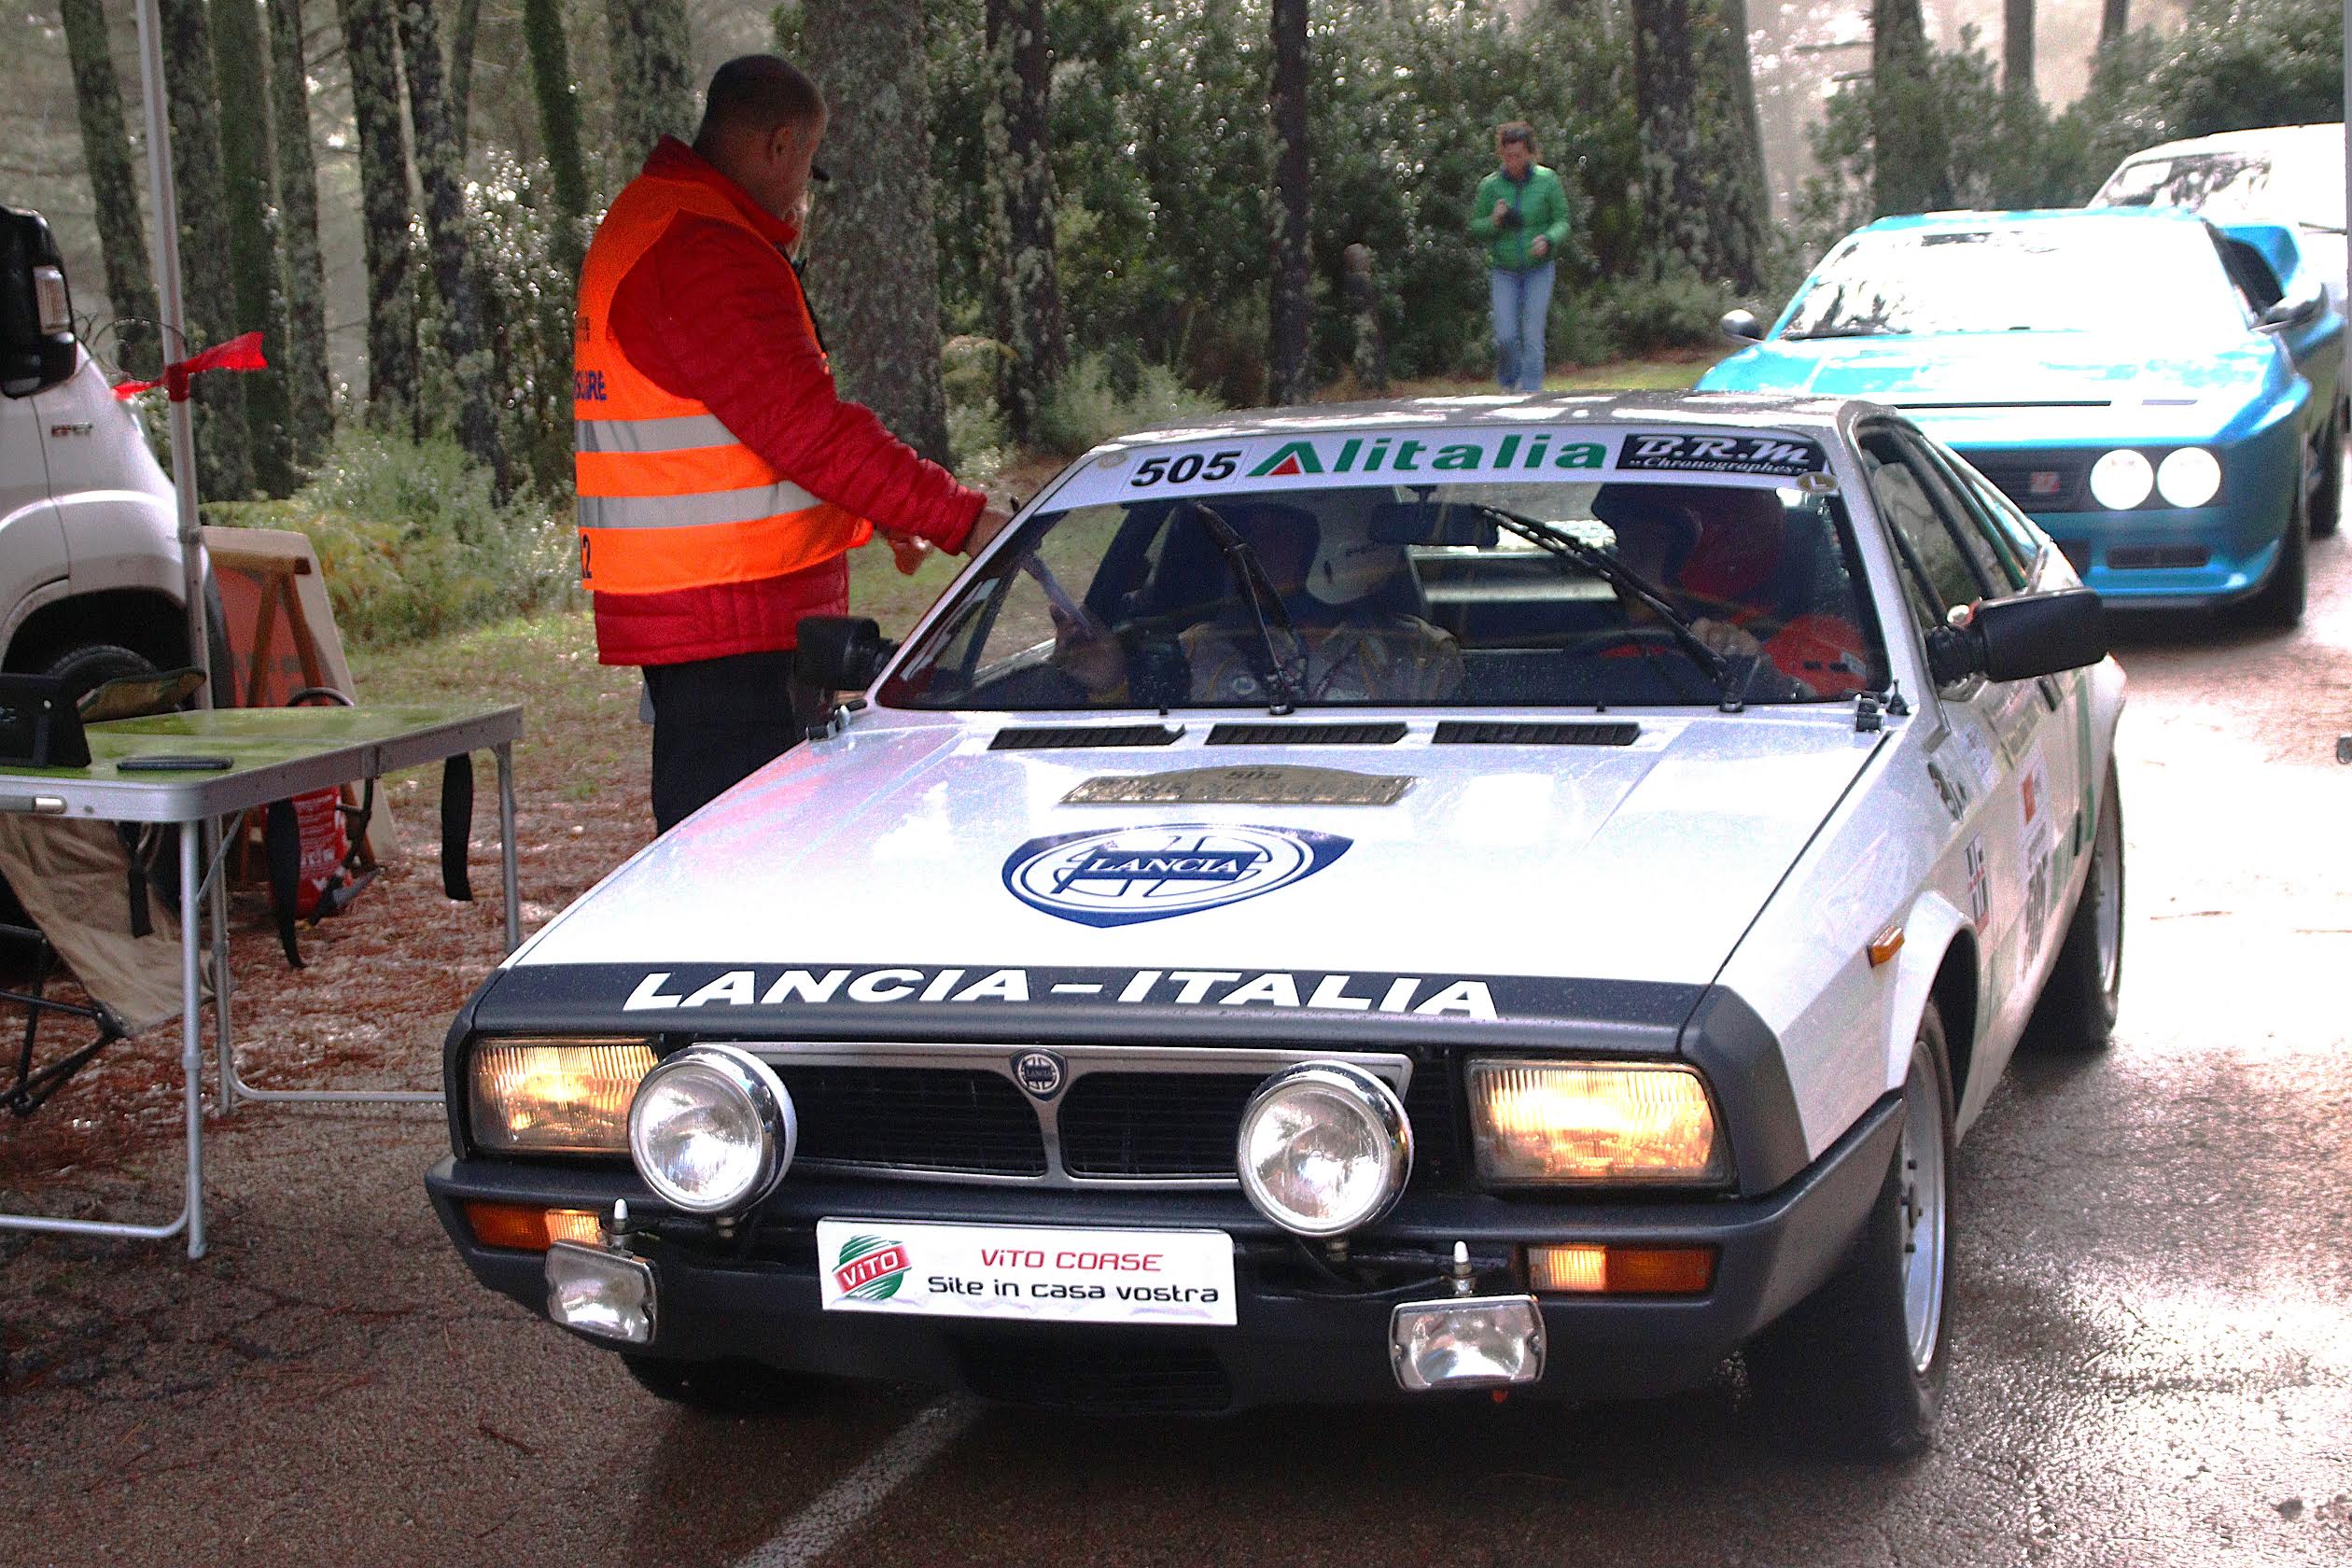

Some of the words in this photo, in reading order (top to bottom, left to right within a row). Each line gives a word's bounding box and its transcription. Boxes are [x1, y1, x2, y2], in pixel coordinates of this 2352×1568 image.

[1130, 450, 1241, 486] 505
[1245, 434, 1607, 477] Alitalia
[1084, 857, 1239, 873] LANCIA
[1055, 1251, 1164, 1272] CORSE
[927, 1275, 984, 1295] Site
[994, 1279, 1020, 1297] in
[1030, 1282, 1106, 1300] casa
[1115, 1284, 1219, 1303] vostra
